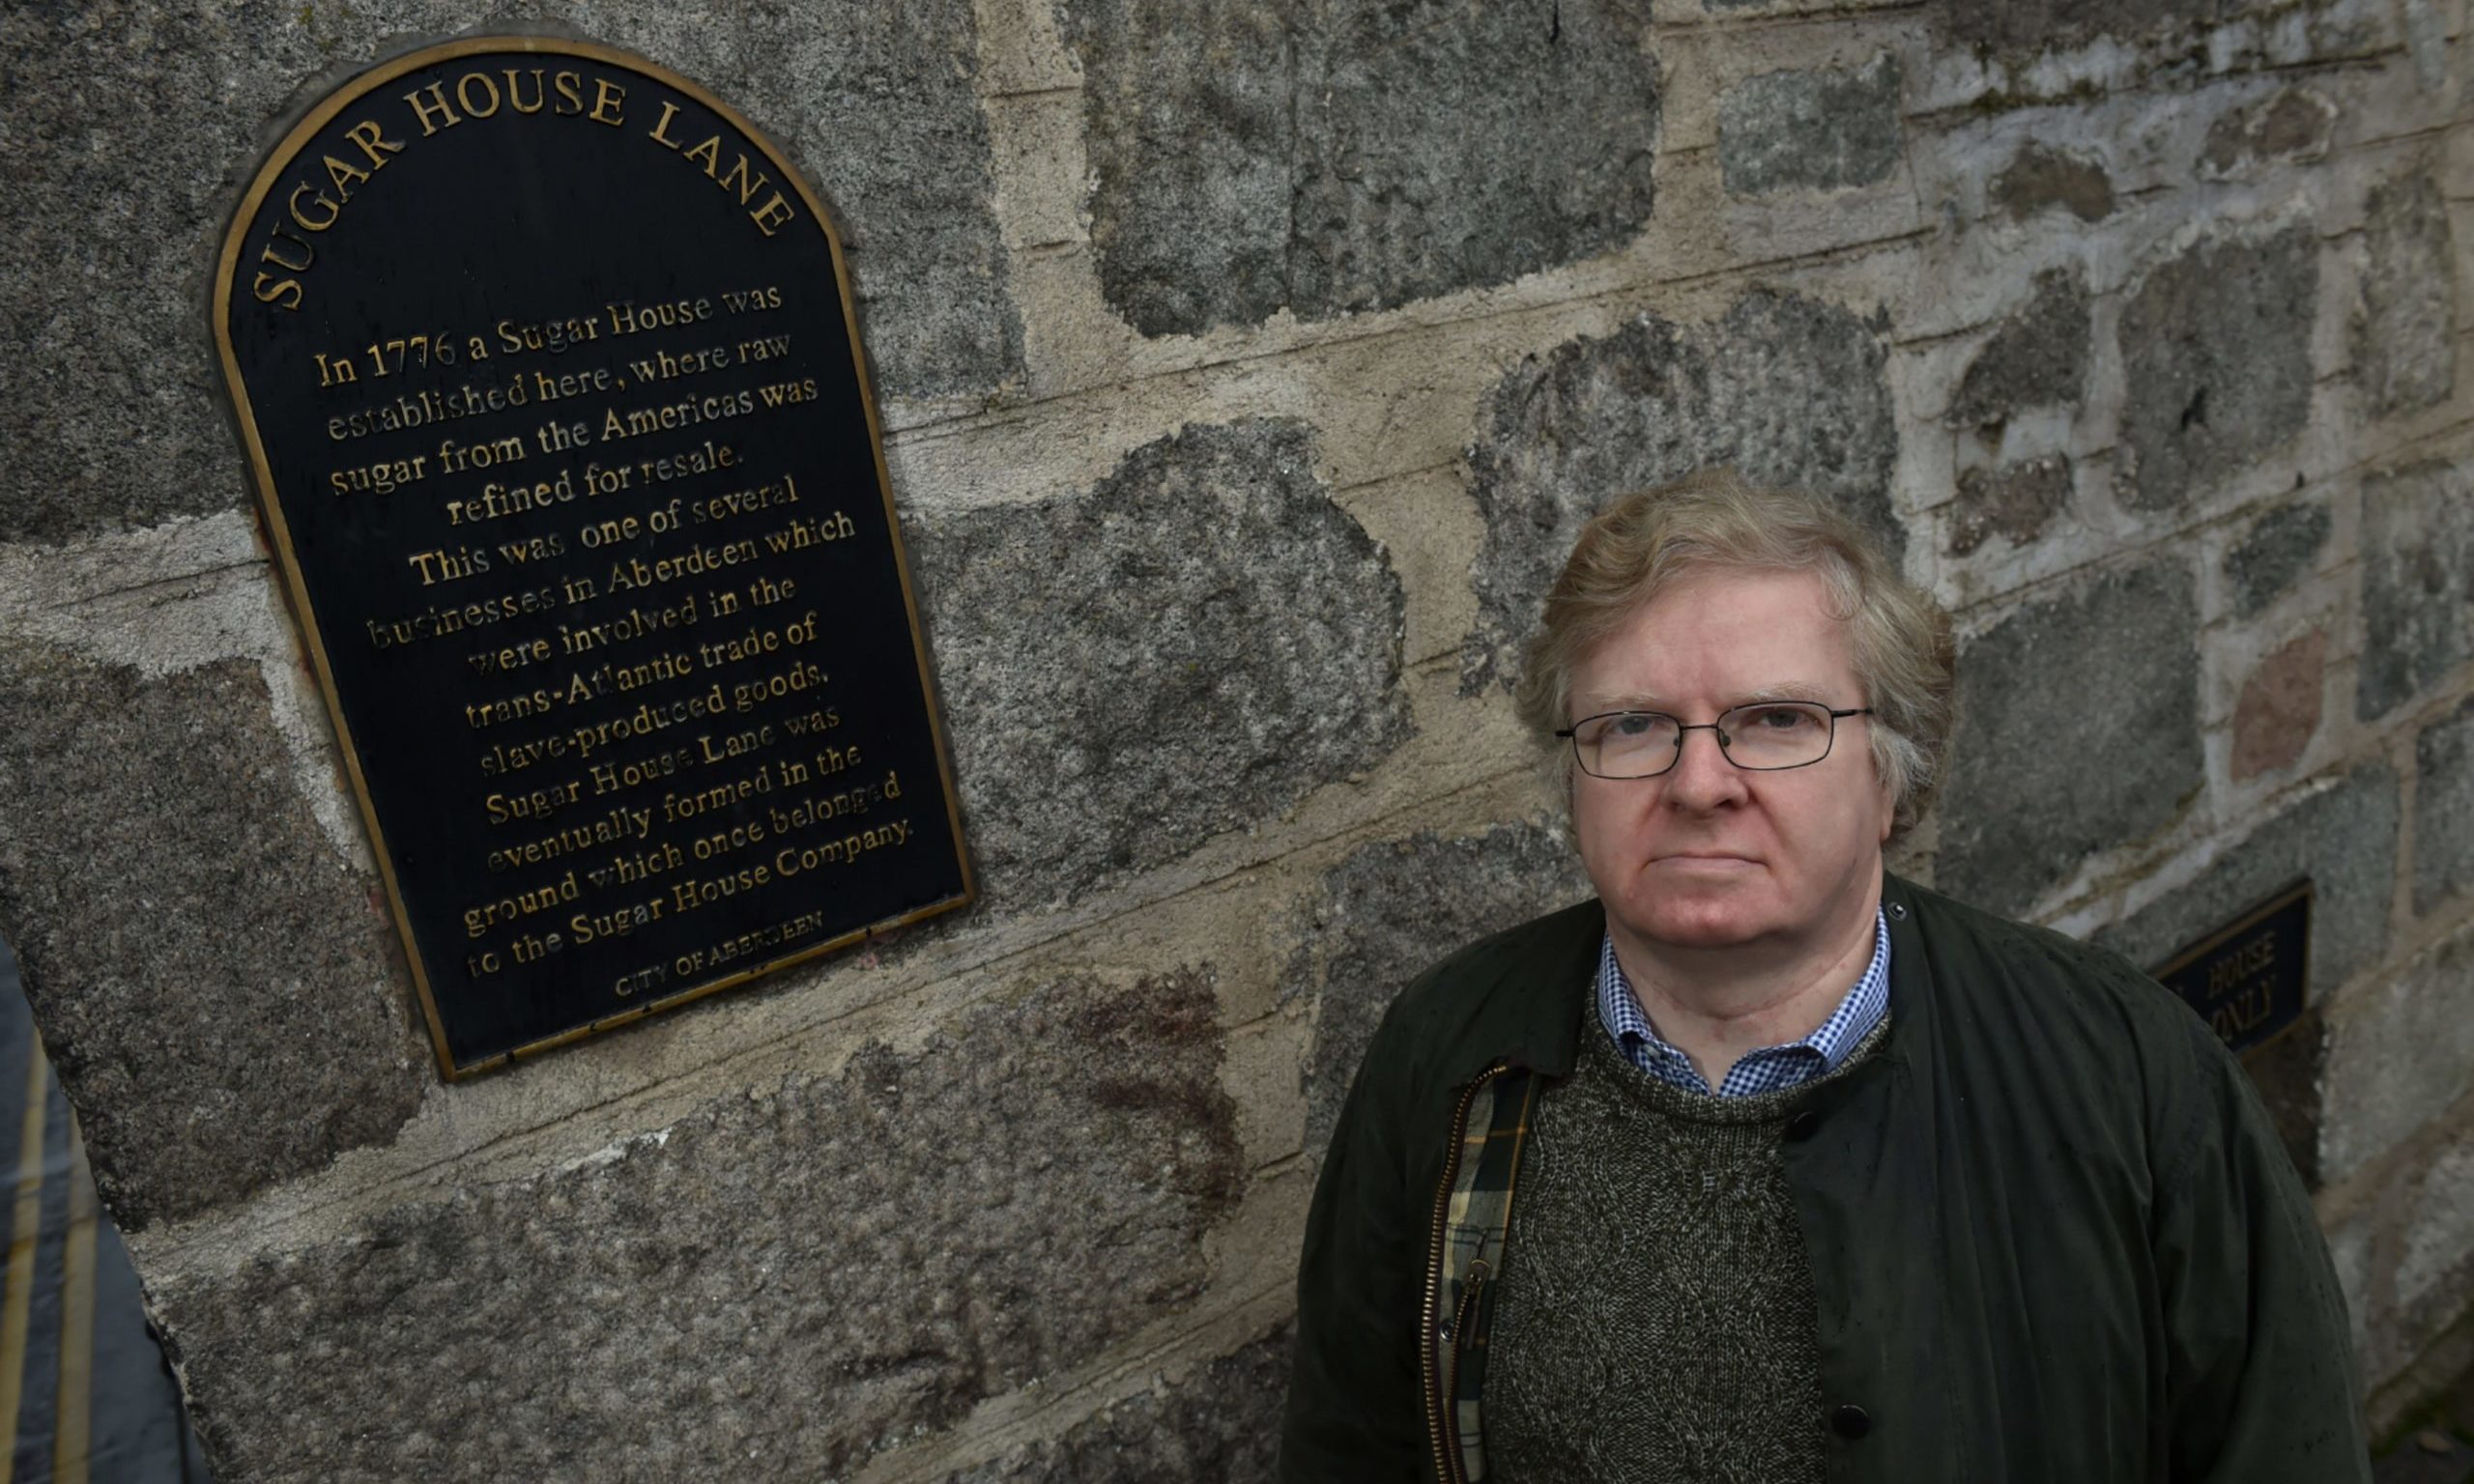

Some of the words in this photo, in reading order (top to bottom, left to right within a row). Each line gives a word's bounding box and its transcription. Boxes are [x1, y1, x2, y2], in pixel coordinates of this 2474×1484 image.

[252, 120, 407, 311] SUGAR
[403, 69, 626, 137] HOUSE
[648, 100, 795, 238] LANE
[313, 353, 359, 387] In
[367, 330, 456, 378] 1776
[468, 335, 489, 362] a
[498, 316, 599, 355] Sugar
[606, 297, 713, 335] House
[722, 286, 782, 315] was
[328, 374, 530, 441] established
[534, 368, 626, 403] here,
[629, 346, 730, 384] where
[737, 334, 791, 364] raw
[330, 456, 426, 497] sugar
[439, 436, 527, 474] from
[536, 421, 590, 454] the
[601, 389, 754, 442] Americas
[759, 379, 819, 409] was
[446, 470, 577, 526] refined
[584, 462, 632, 498] for
[641, 441, 744, 484] resale.
[366, 586, 556, 649] businesses
[562, 576, 597, 605] in
[608, 543, 759, 594] Aberdeen
[765, 510, 856, 555] which
[408, 543, 491, 586] This
[499, 532, 565, 565] was
[581, 517, 640, 549] one
[649, 498, 682, 533] of
[692, 473, 800, 523] several
[465, 652, 693, 729] trans-Atlantic
[700, 626, 780, 669] trade
[786, 609, 818, 646] of
[468, 638, 551, 676] were
[559, 595, 698, 655] involved
[708, 590, 741, 617] in
[750, 576, 796, 607] the
[480, 684, 727, 777] slave-produced
[485, 780, 580, 824] Sugar
[589, 749, 694, 795] House
[698, 726, 776, 764] Lane
[785, 705, 841, 737] was
[464, 871, 580, 938] ground
[588, 842, 685, 888] which
[693, 820, 764, 861] once
[769, 770, 902, 835] belonged
[487, 807, 650, 872] eventually
[663, 764, 773, 823] formed
[780, 759, 811, 786] in
[816, 744, 862, 776] the
[467, 952, 502, 979] to
[511, 931, 563, 964] the
[570, 898, 665, 945] Sugar
[672, 865, 771, 913] House
[775, 818, 914, 876] Company.
[615, 960, 669, 997] CITY
[676, 951, 704, 976] OF
[2208, 929, 2276, 999] HOUSE
[2211, 973, 2276, 1042] ONLY
